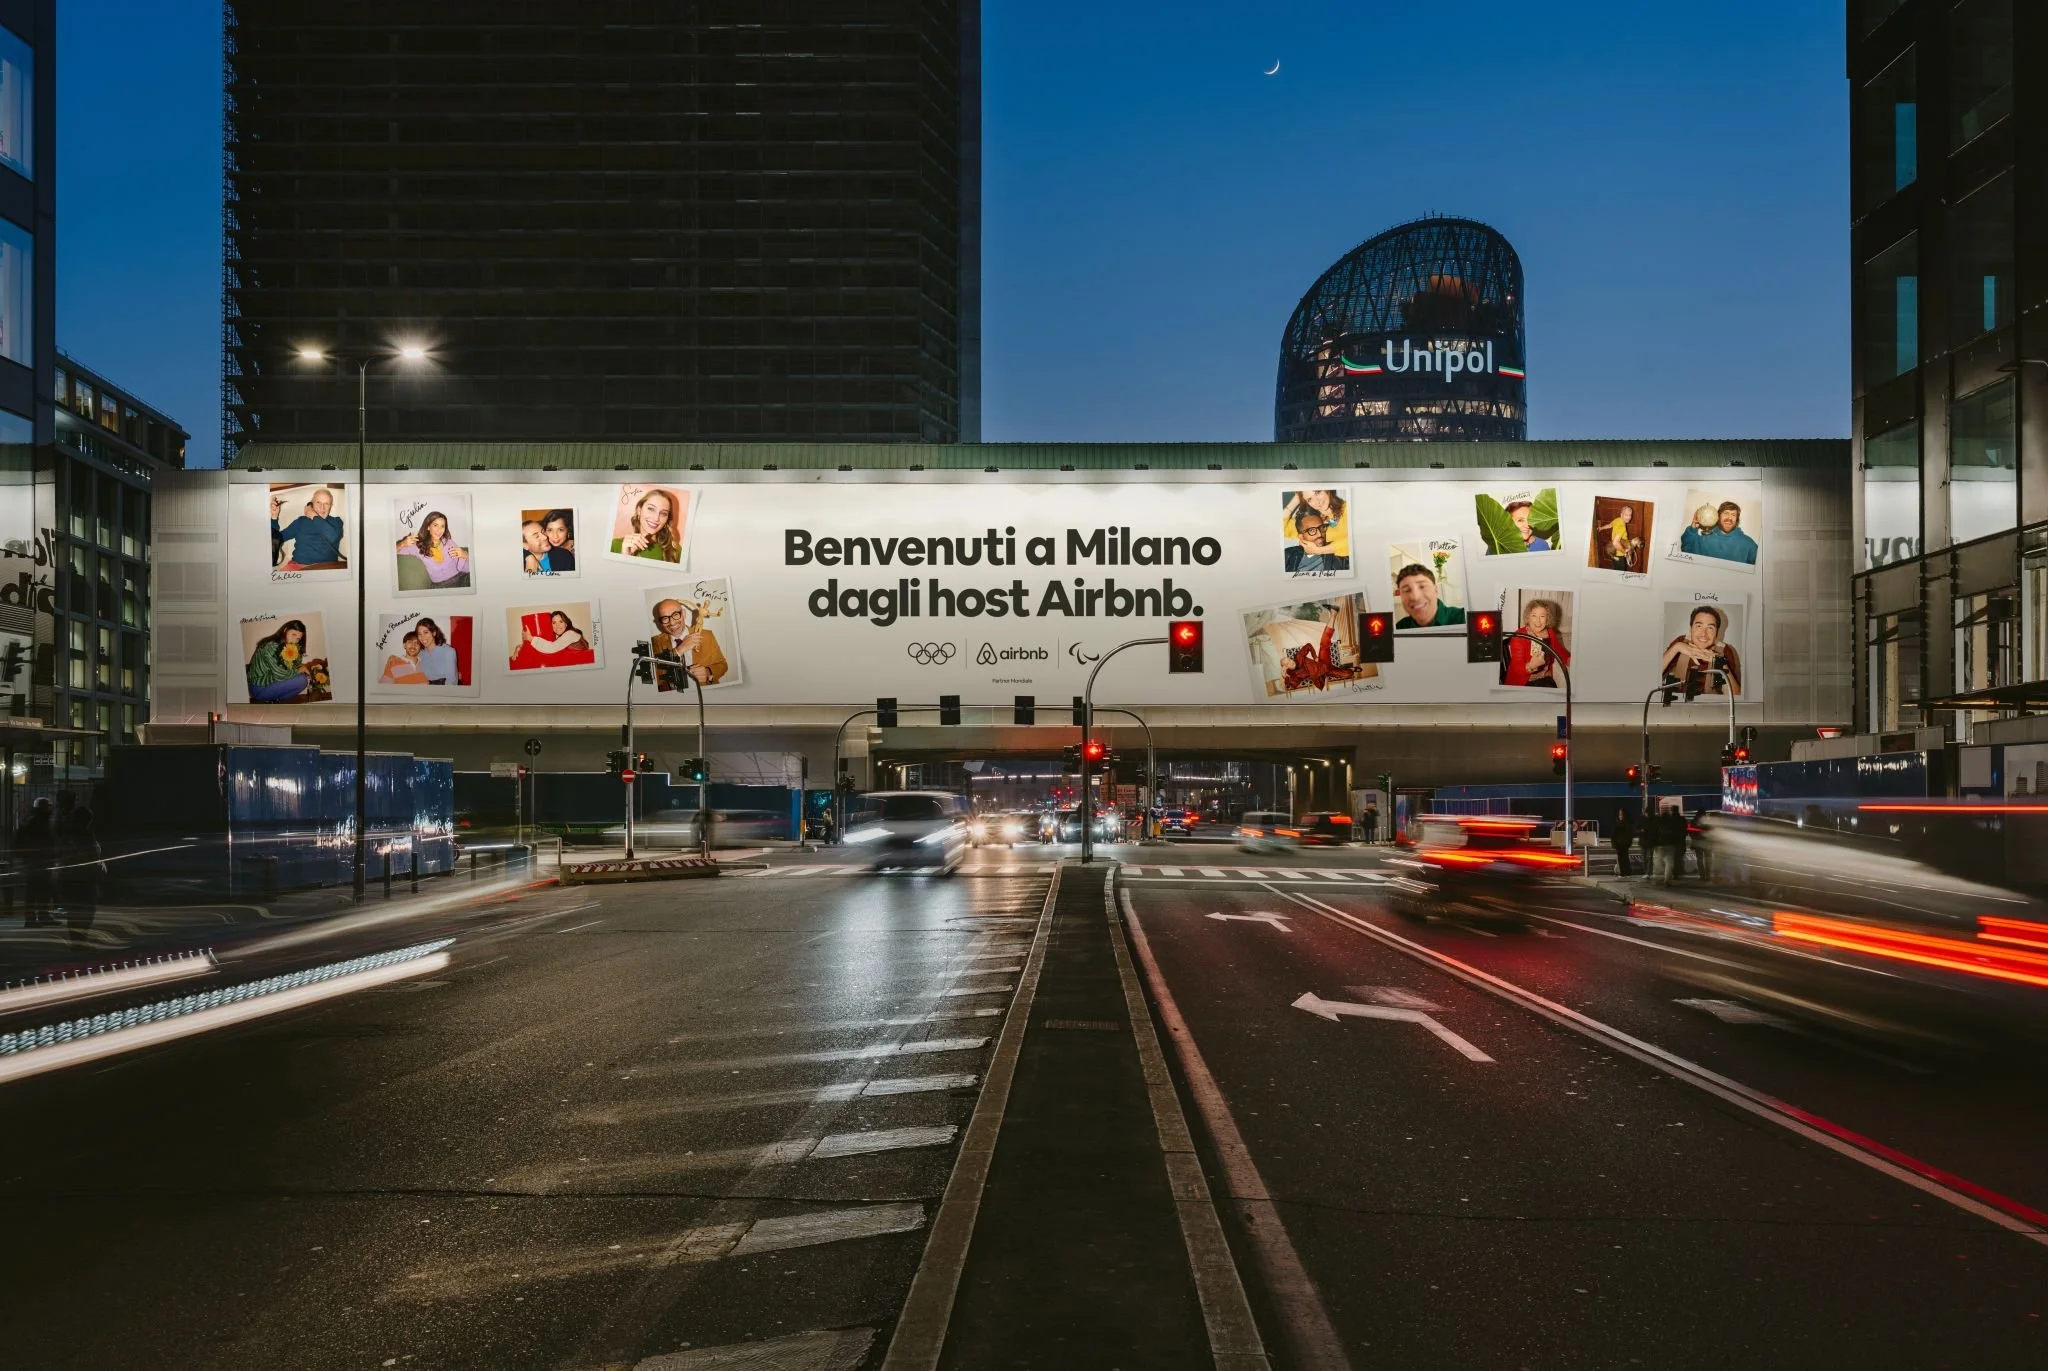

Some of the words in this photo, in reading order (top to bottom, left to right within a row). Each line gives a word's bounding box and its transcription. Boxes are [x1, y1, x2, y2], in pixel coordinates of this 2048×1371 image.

[1386, 339, 1493, 383] Unipol
[785, 526, 1016, 567] Benvenuti
[1025, 536, 1055, 566] a
[1066, 526, 1222, 567] Milano
[808, 577, 921, 627] dagli
[929, 578, 1030, 618] host
[1036, 577, 1204, 618] Airbnb.
[1694, 592, 1719, 602] Davide
[1000, 646, 1049, 660] airbnb
